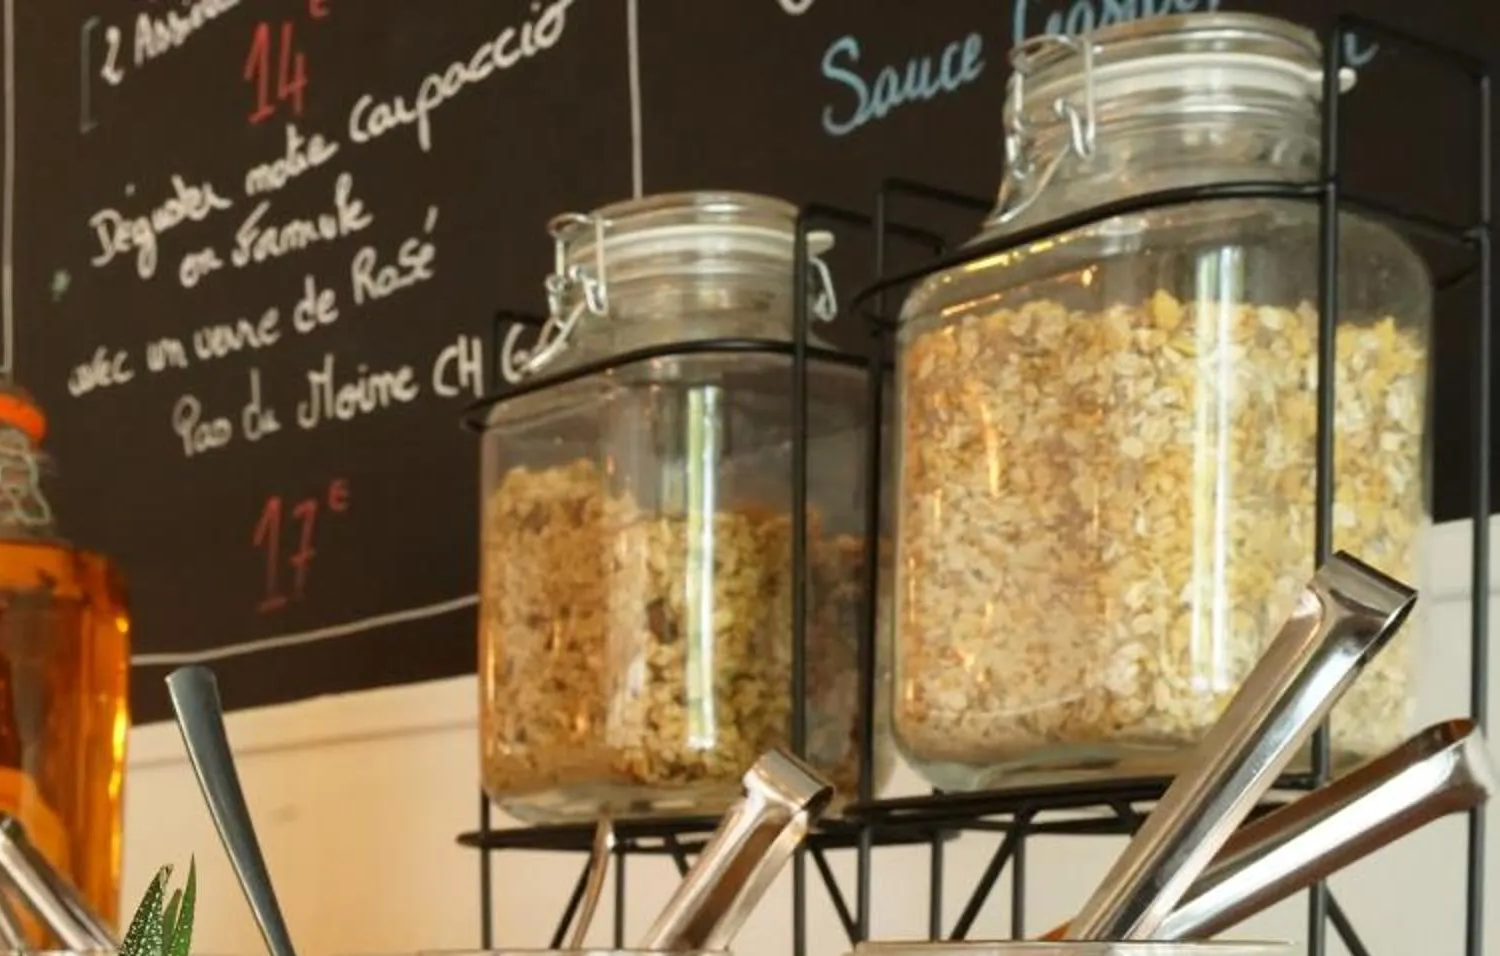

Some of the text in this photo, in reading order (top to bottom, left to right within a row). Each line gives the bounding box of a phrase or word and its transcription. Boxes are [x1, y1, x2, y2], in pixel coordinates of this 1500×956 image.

[101, 26, 124, 85] 2
[820, 32, 985, 137] Sauce
[292, 273, 340, 334] de
[351, 204, 438, 306] Rosé
[432, 334, 485, 398] CH
